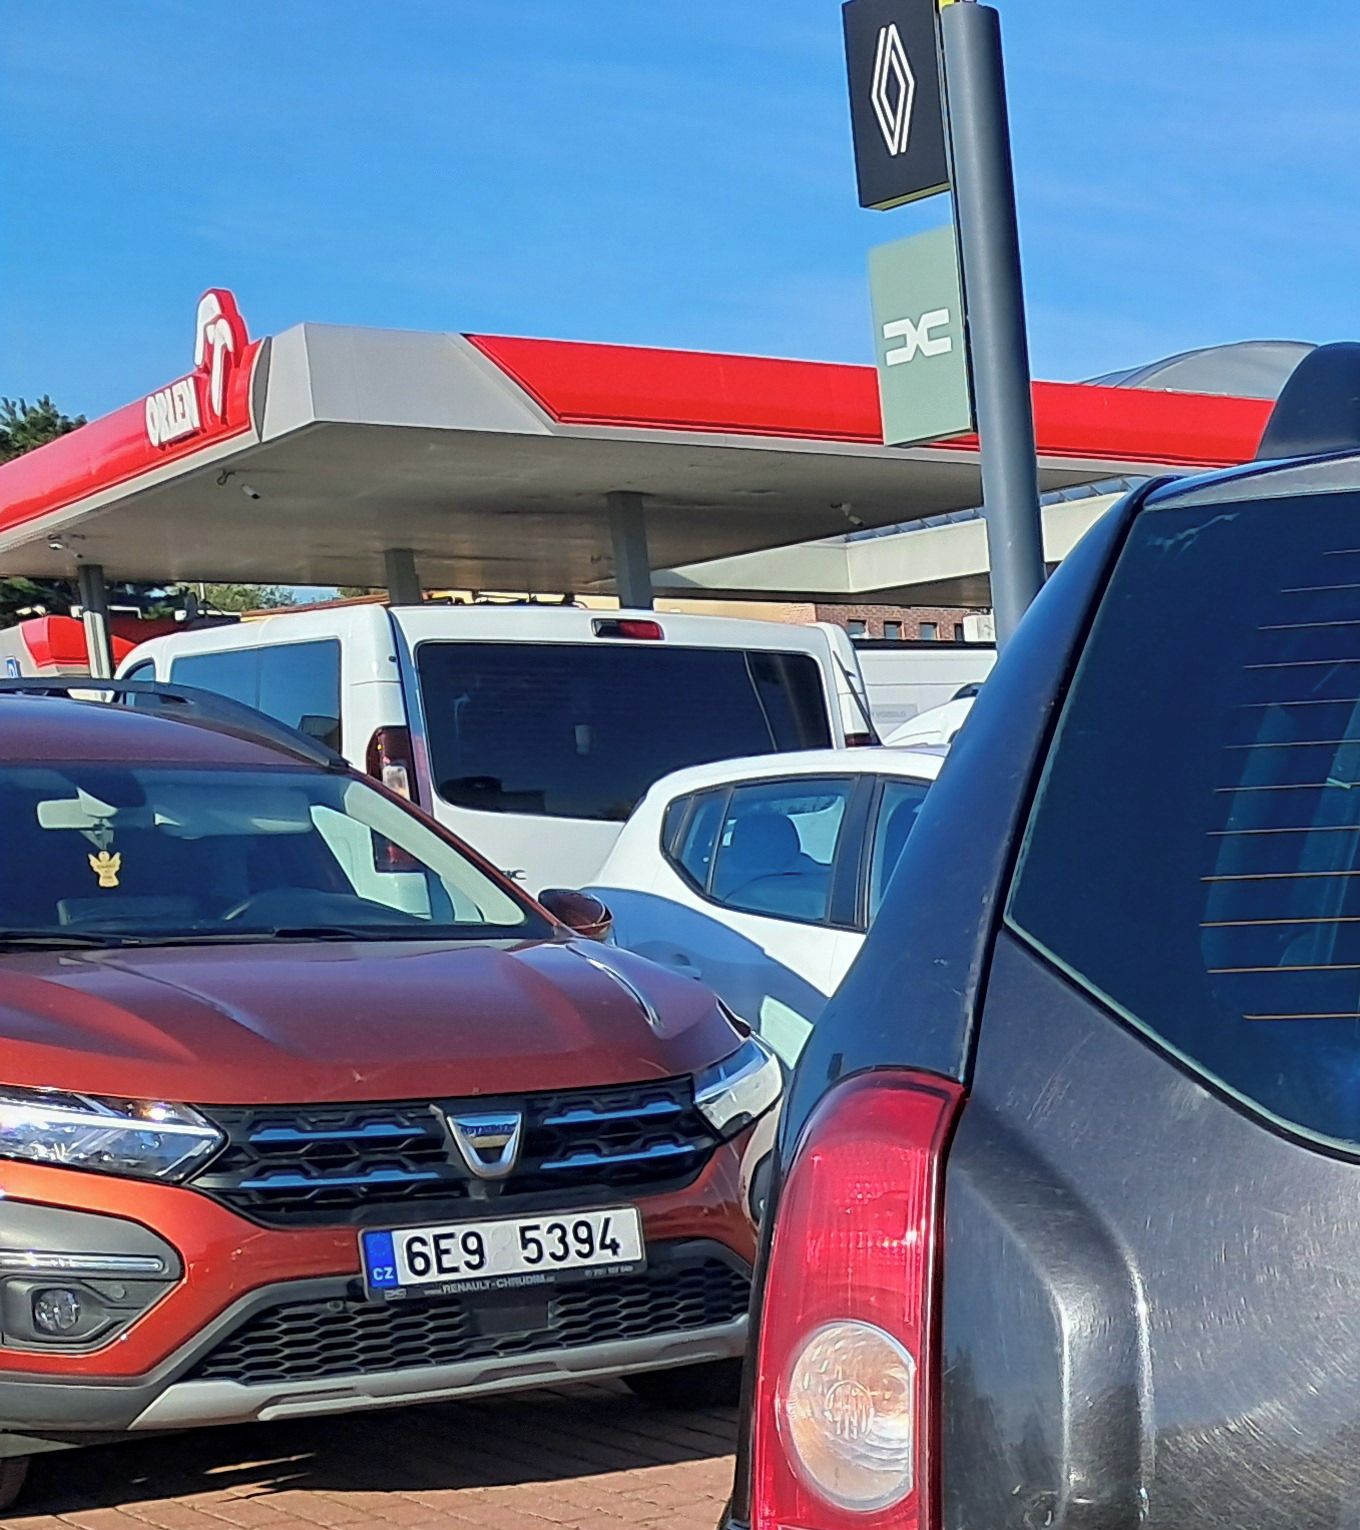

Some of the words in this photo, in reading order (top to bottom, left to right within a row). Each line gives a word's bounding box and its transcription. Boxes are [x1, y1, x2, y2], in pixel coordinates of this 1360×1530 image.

[145, 376, 201, 448] ORLEN
[373, 1266, 394, 1281] CZ
[404, 1231, 486, 1278] 6E9
[518, 1216, 621, 1265] 5394
